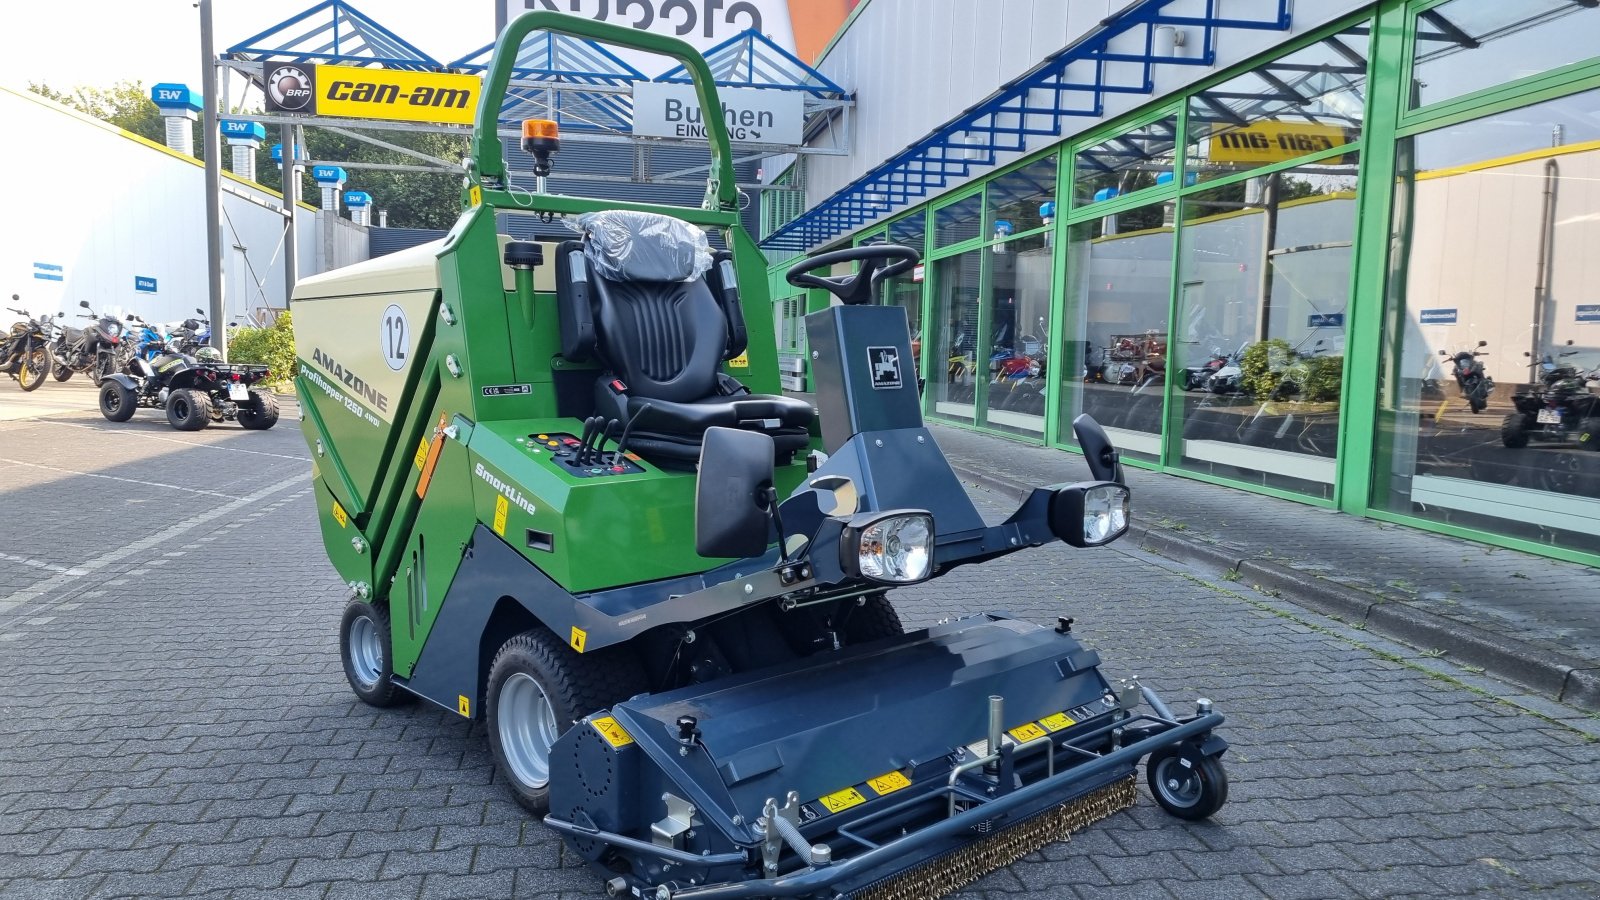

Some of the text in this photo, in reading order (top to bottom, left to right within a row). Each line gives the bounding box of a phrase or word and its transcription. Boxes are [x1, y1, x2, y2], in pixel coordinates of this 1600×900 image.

[286, 89, 310, 97] BRP
[665, 98, 773, 128] Buhen
[676, 124, 746, 140] EINNG
[386, 316, 405, 360] 12
[300, 364, 344, 402] Profihopper
[344, 396, 363, 418] 1250
[312, 348, 388, 414] AMAZONE
[475, 462, 536, 516] SmartLine
